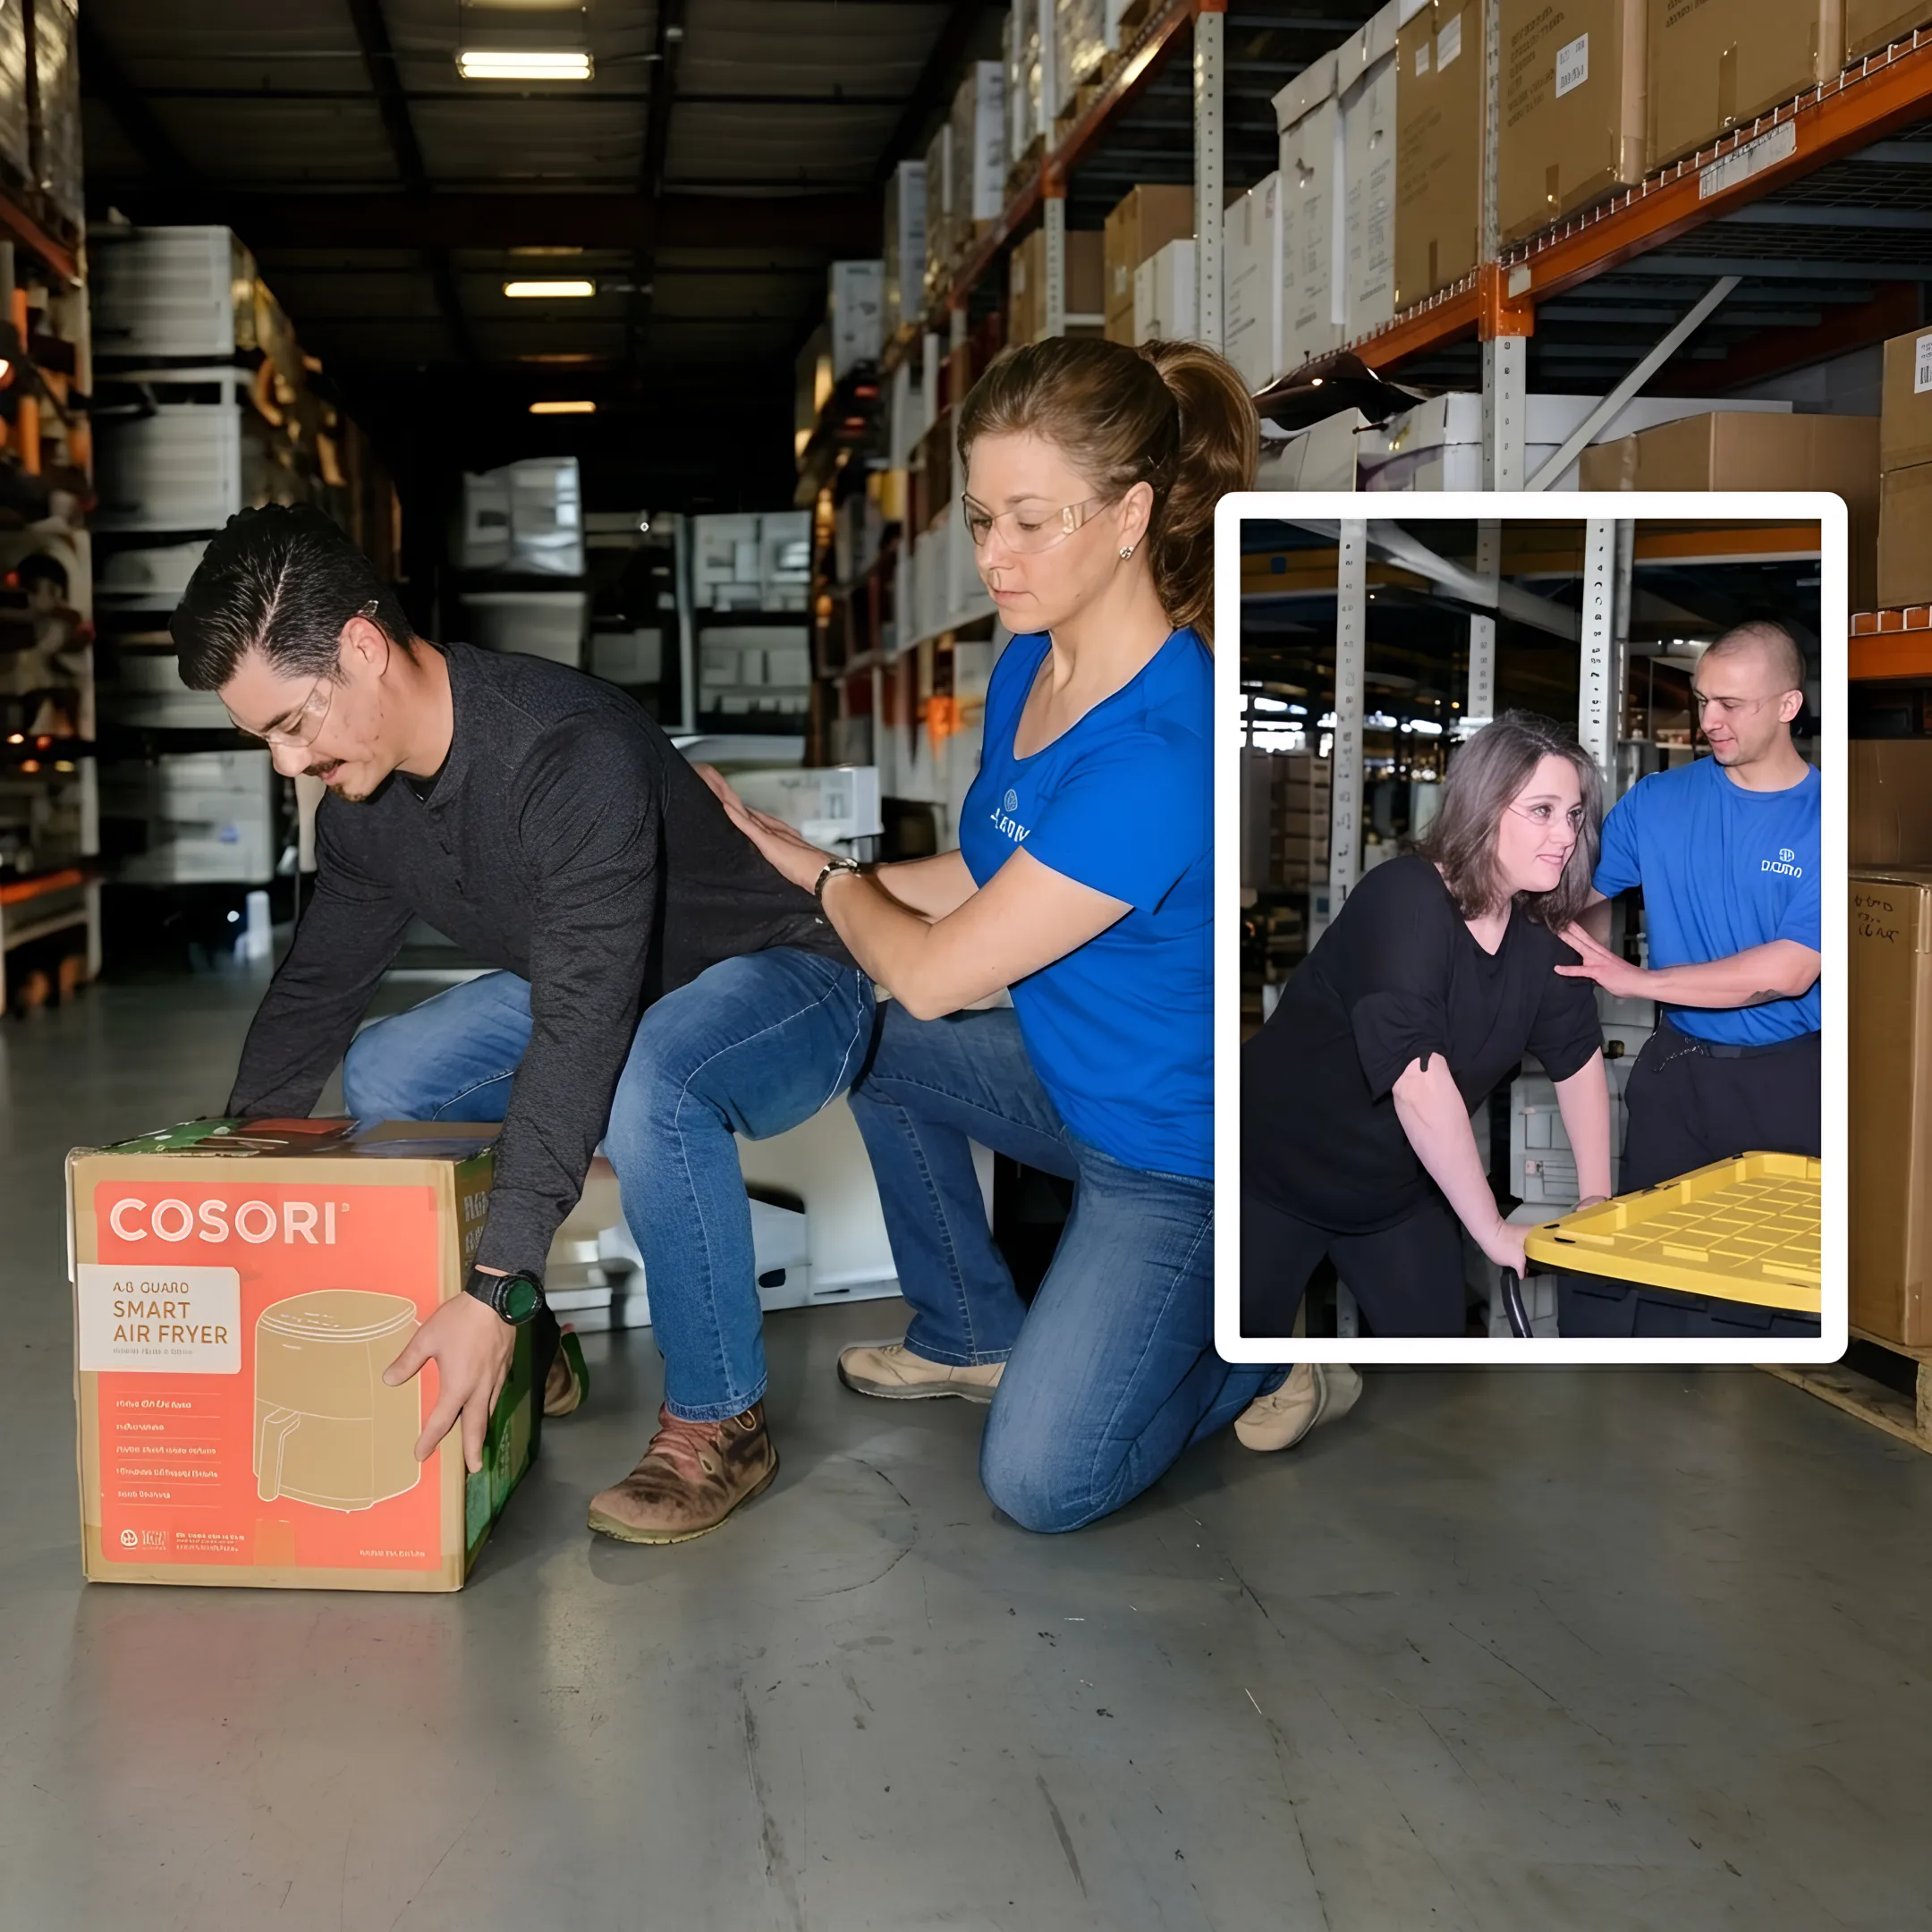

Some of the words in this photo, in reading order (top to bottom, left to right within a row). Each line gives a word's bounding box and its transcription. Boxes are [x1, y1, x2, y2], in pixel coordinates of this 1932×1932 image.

[109, 1198, 336, 1244] COSORI
[113, 1300, 191, 1319] SMART
[113, 1323, 151, 1343] AIR
[158, 1324, 228, 1344] FRYER
